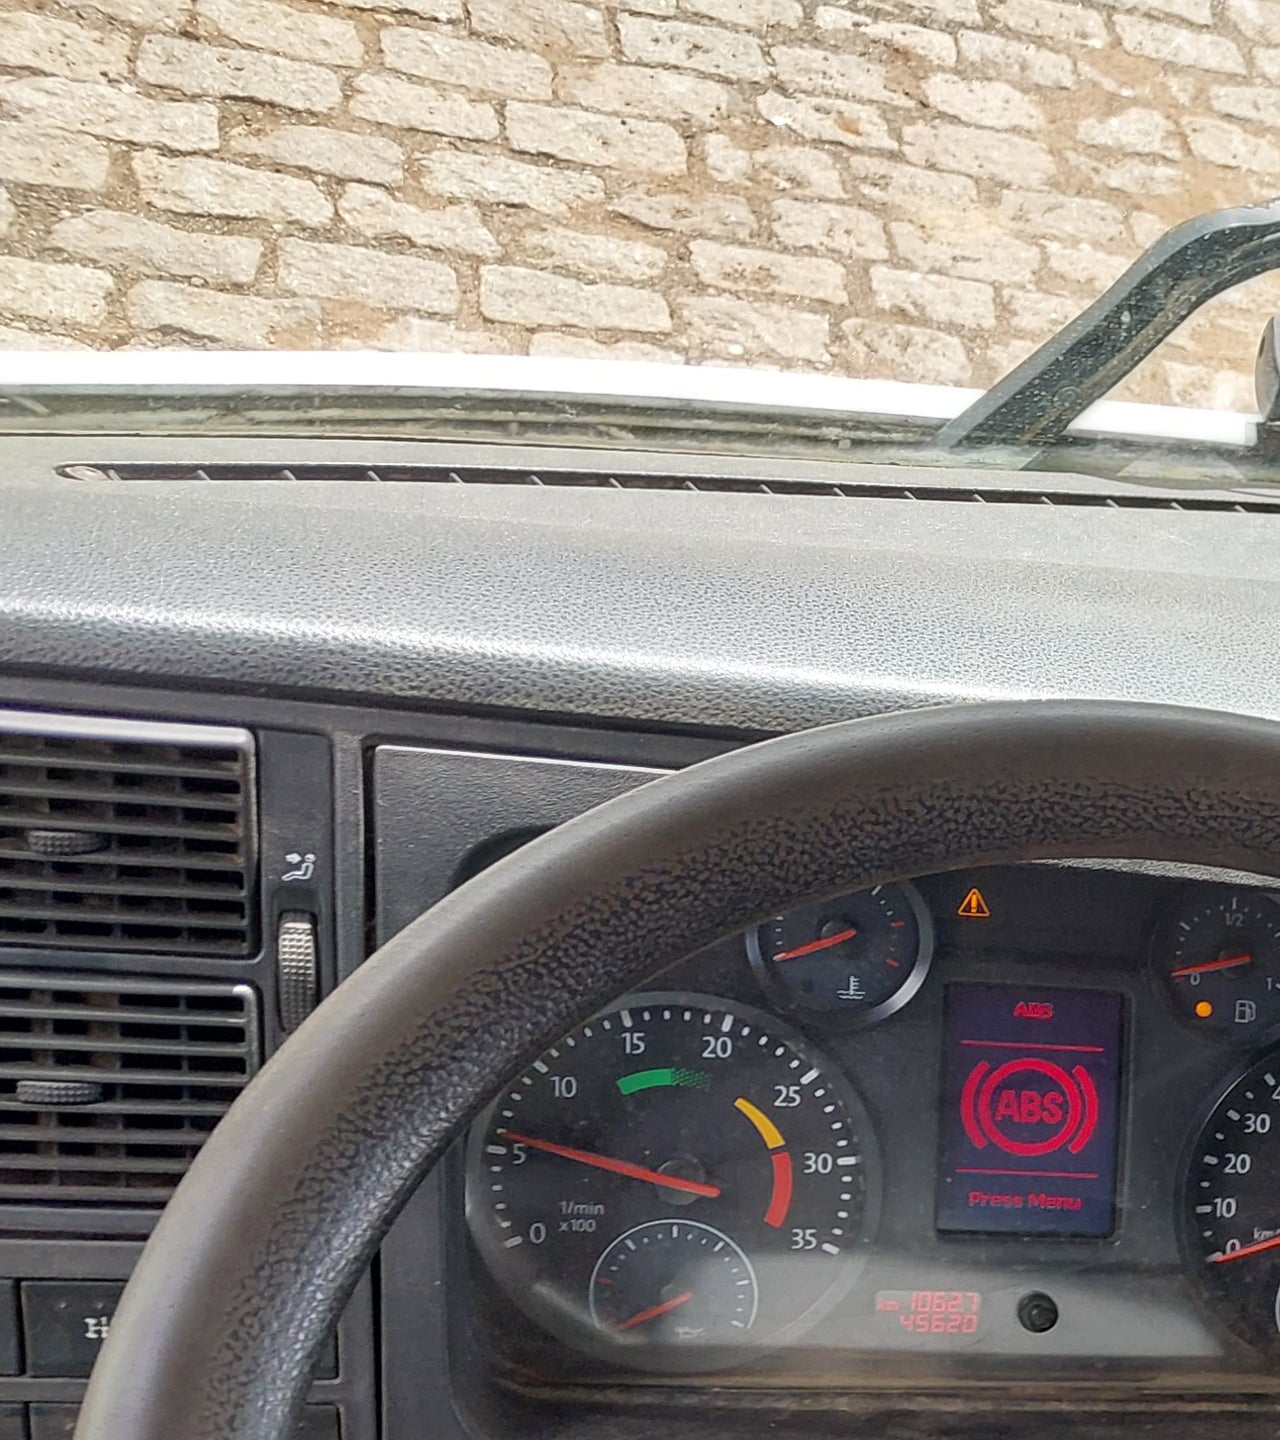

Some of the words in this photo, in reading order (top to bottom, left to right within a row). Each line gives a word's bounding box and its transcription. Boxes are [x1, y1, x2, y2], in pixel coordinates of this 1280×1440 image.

[1190, 973, 1200, 986] 0
[1266, 977, 1272, 990] 1
[1012, 1002, 1054, 1020] ABS
[621, 1032, 646, 1054] 15
[702, 1036, 732, 1058] 20
[550, 1076, 577, 1098] 10
[773, 1085, 801, 1107] 25
[995, 1090, 1063, 1124] ABS
[1243, 1113, 1271, 1133] 30
[512, 1143, 526, 1164] 5
[803, 1153, 832, 1174] 30
[1223, 1153, 1251, 1174] 20
[559, 1201, 605, 1215] 1/min
[968, 1191, 1023, 1208] Press
[1027, 1193, 1082, 1211] Menu
[1213, 1198, 1237, 1218] 10
[529, 1222, 547, 1244] 0
[558, 1219, 597, 1232] x100
[791, 1228, 817, 1250] 35
[1226, 1239, 1241, 1254] 0
